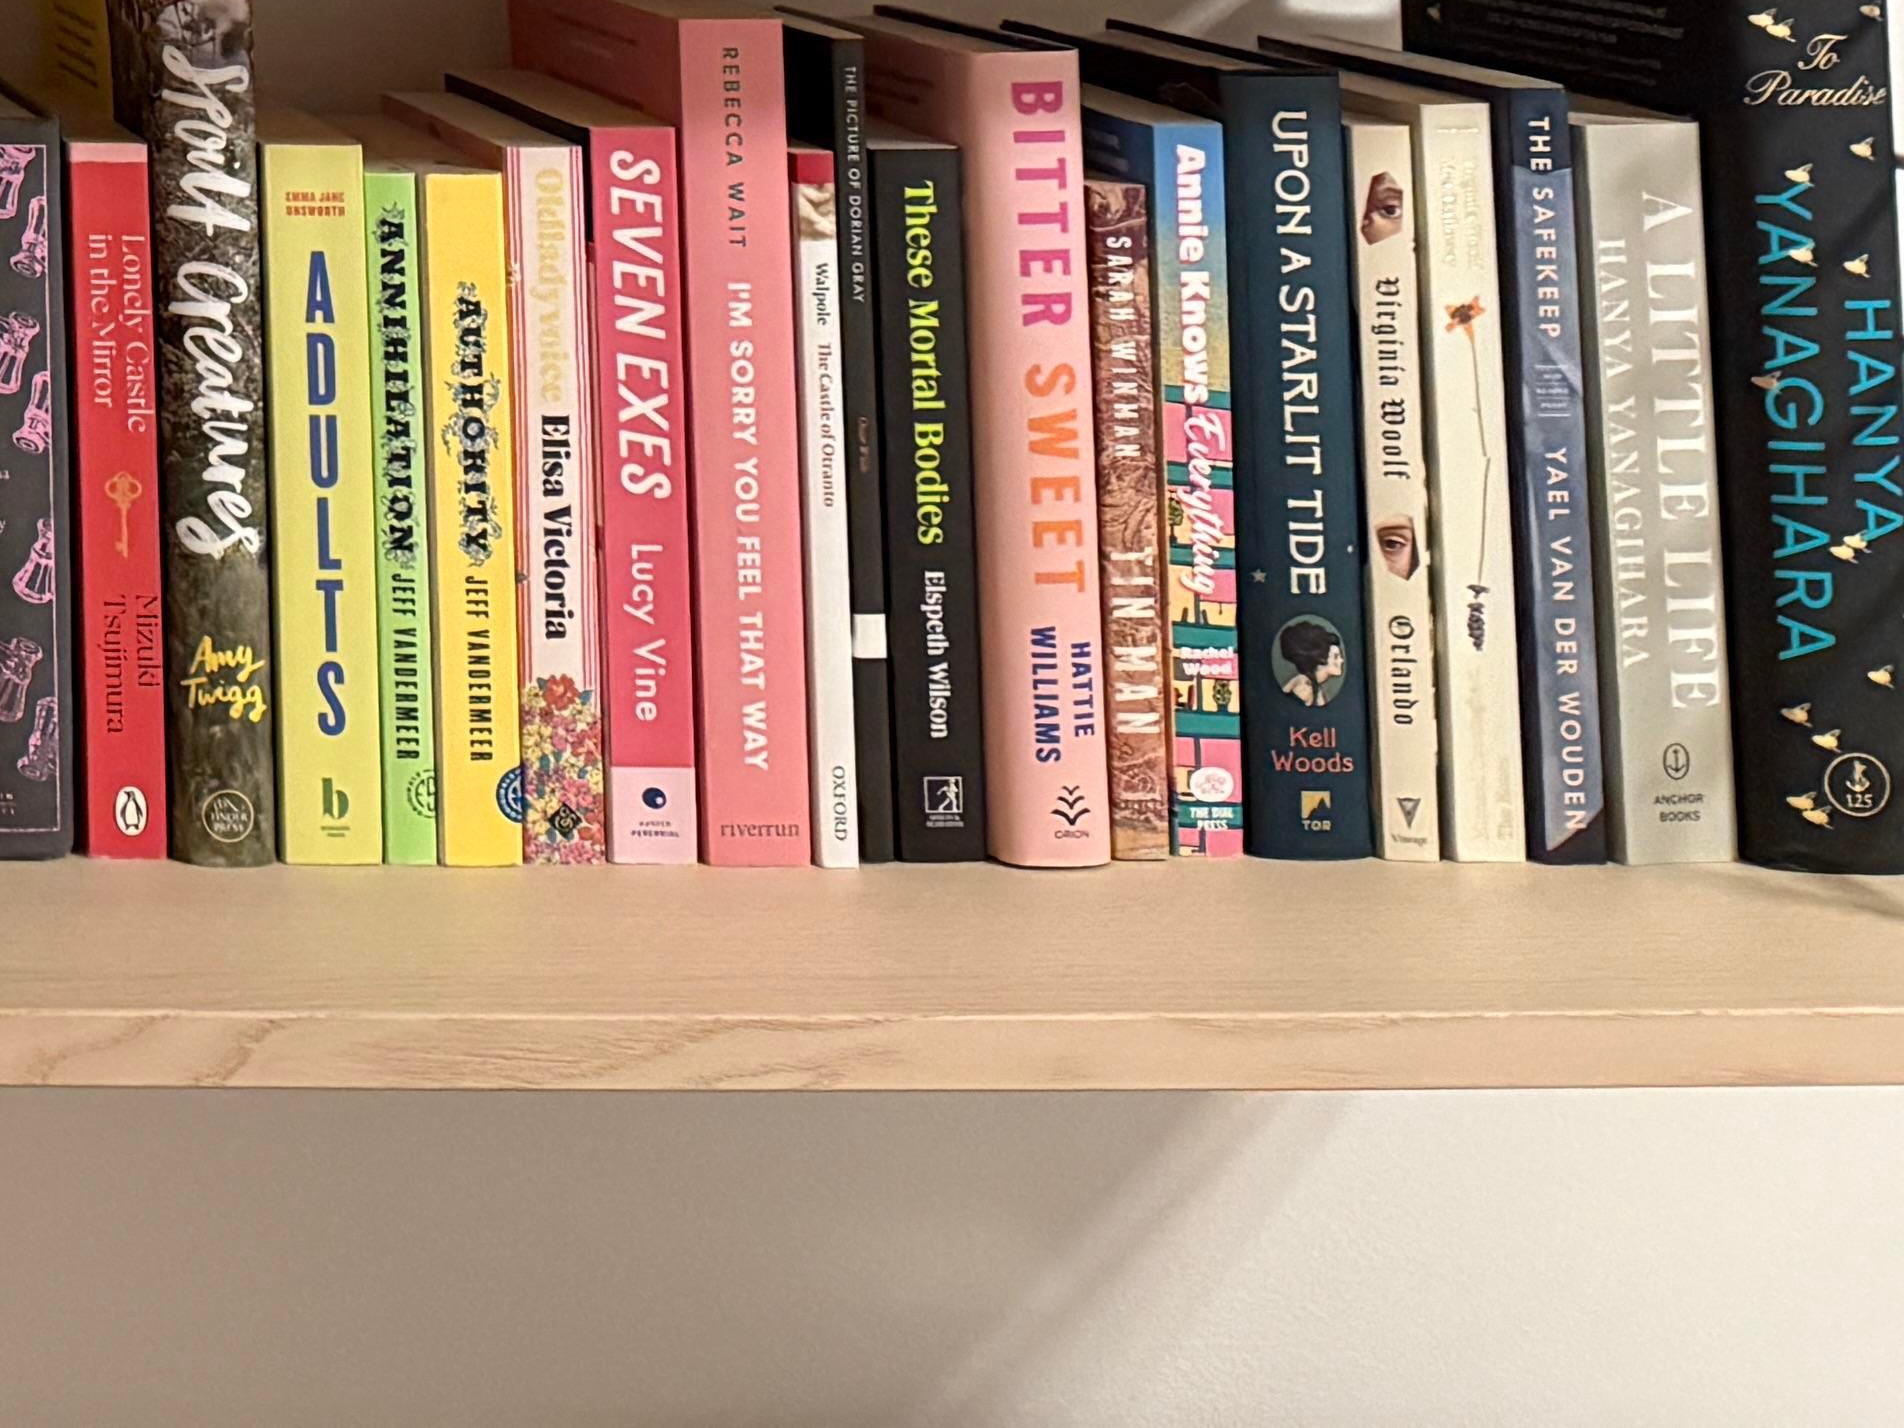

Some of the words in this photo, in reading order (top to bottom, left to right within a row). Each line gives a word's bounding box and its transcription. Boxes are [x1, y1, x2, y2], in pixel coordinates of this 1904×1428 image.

[1744, 73, 1888, 109] Paradise
[1795, 34, 1841, 70] To
[610, 148, 672, 343] SEVEN
[1010, 80, 1074, 333] BITTER
[1640, 189, 1696, 233] A
[616, 351, 675, 499] EXES
[1644, 258, 1714, 525] LITTLE
[1753, 181, 1838, 663] YANAGIHARA
[1843, 297, 1903, 544] HANYA
[304, 250, 348, 738] ADULTS
[1024, 361, 1087, 595] SWEET
[1662, 544, 1721, 711] LIFE
[1272, 749, 1355, 774] Woods
[1287, 726, 1338, 748] Kell
[1841, 792, 1874, 810] 125
[1301, 817, 1332, 831] TOR
